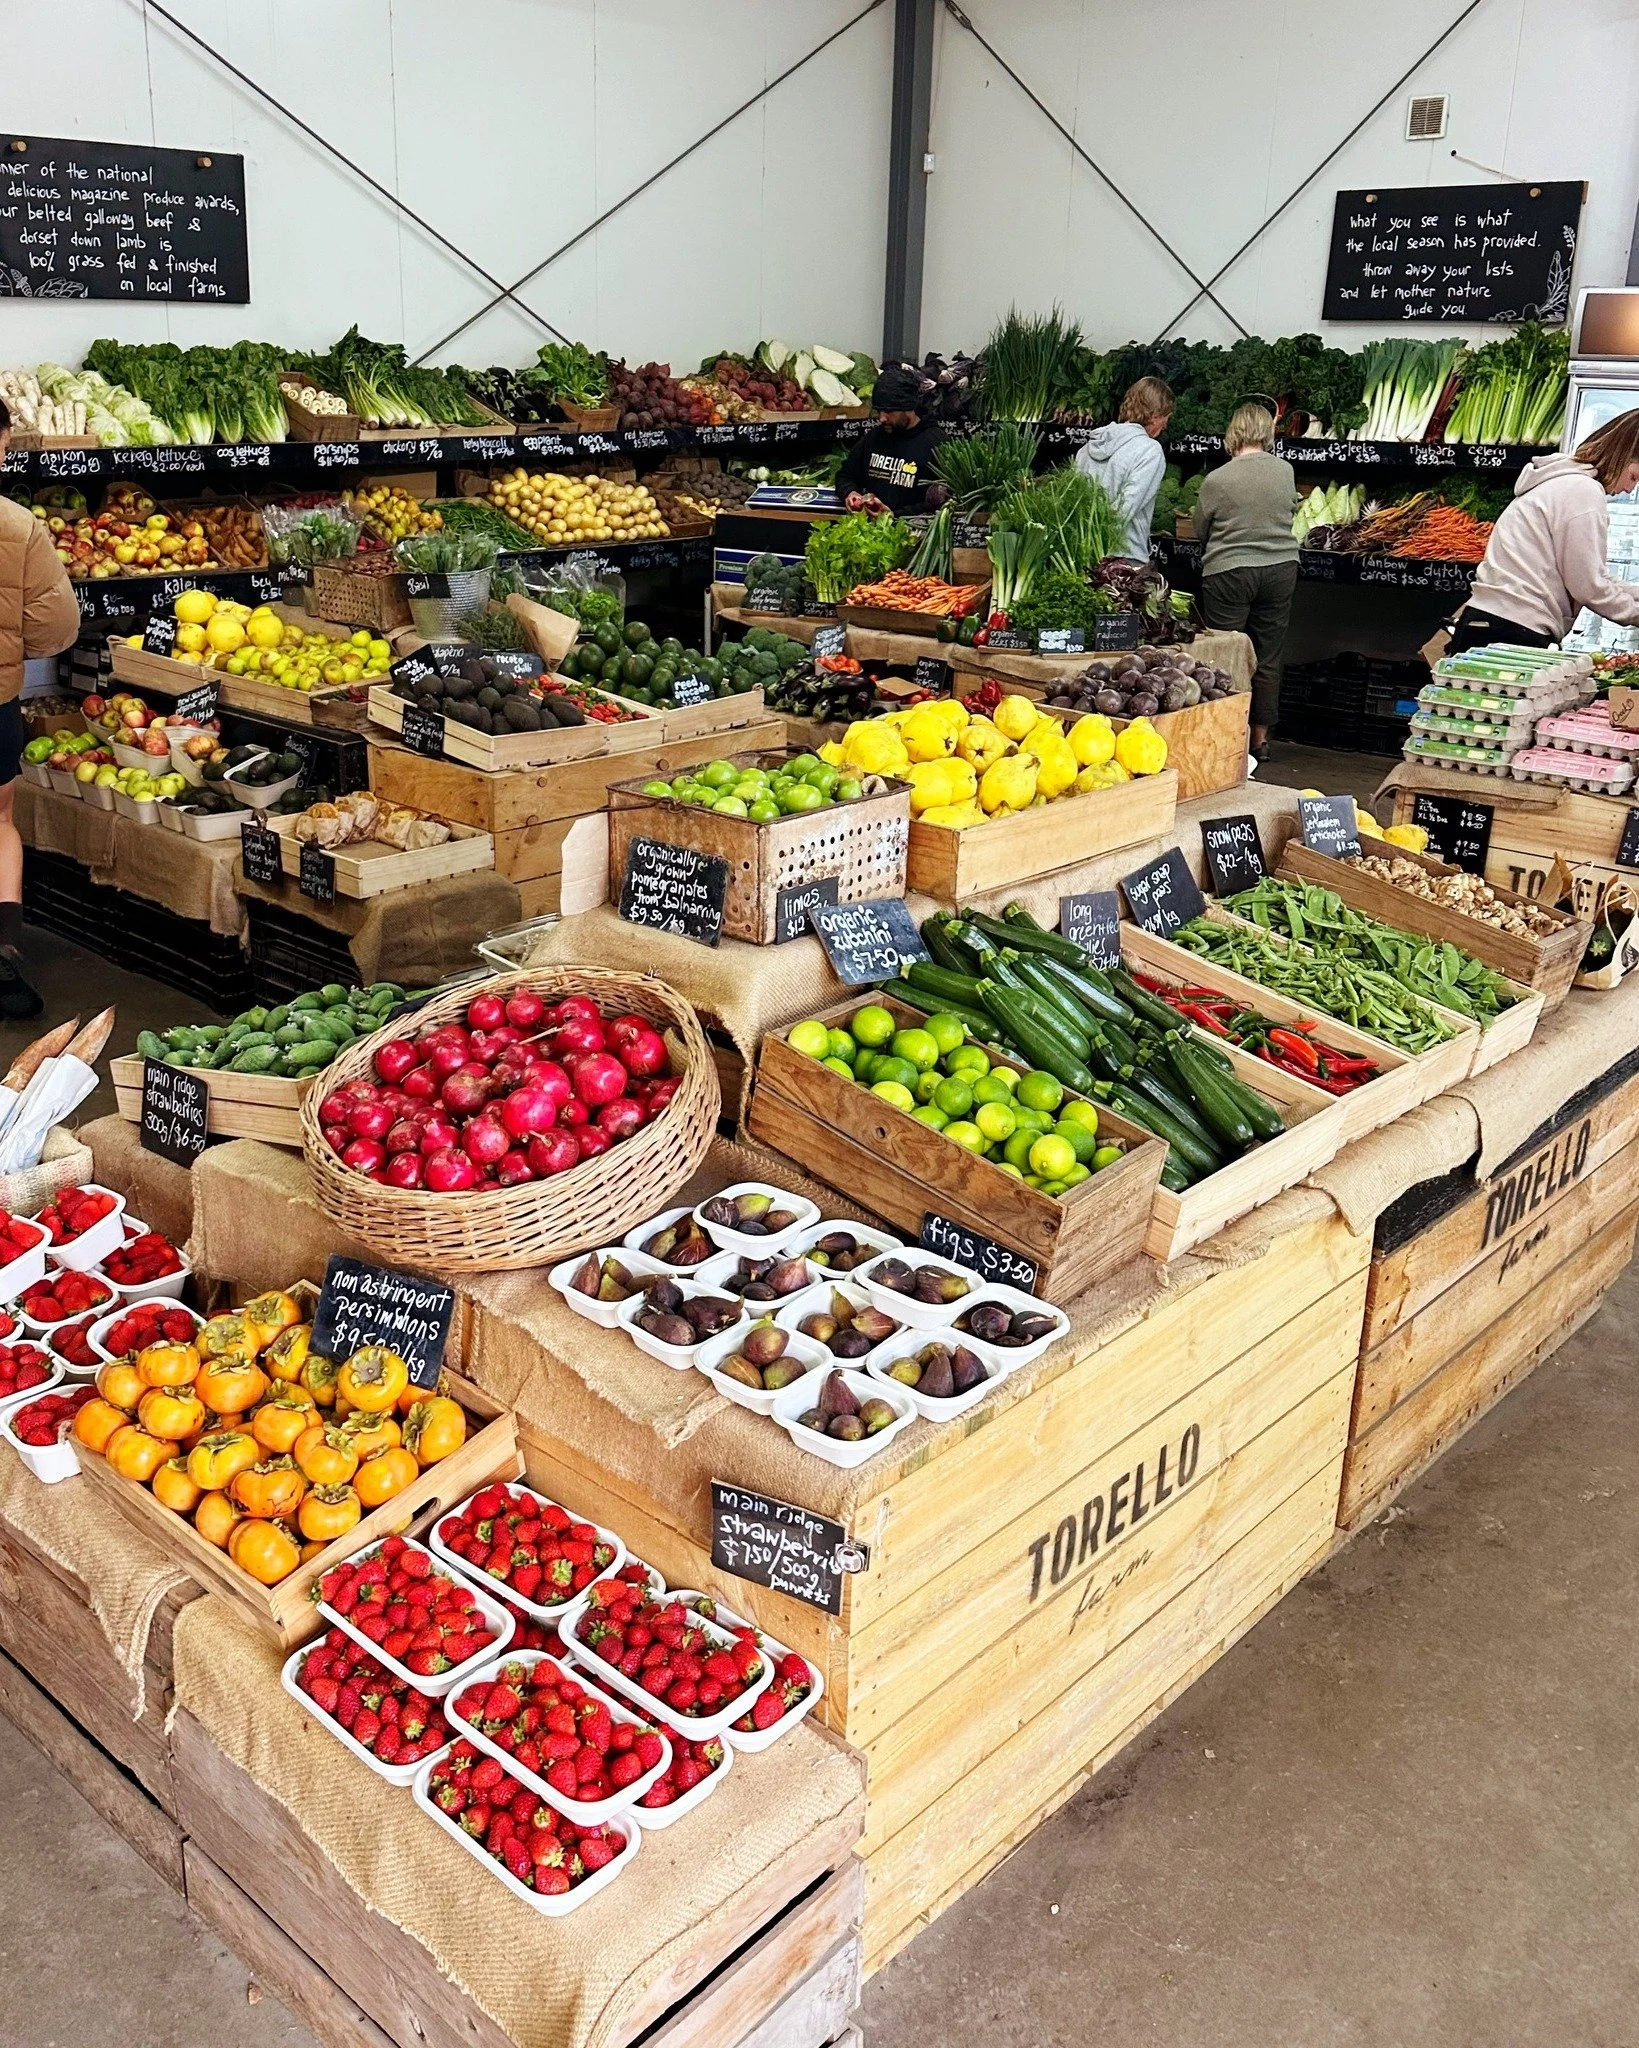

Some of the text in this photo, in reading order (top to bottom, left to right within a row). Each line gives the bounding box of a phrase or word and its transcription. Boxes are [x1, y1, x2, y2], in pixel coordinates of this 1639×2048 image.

[0, 161, 153, 185] nner of the national
[8, 181, 240, 216] delicious magazine produce awards,
[28, 202, 202, 232] belted galloway beef &
[1350, 208, 1513, 233] what you see is what
[19, 227, 173, 252] dorset down lamb is
[1346, 231, 1542, 257] the local season has provided.
[29, 250, 217, 275] 100% grass fed & finished
[1362, 260, 1514, 282] throw away your lists
[120, 275, 226, 297] on local farms
[1340, 281, 1492, 299] and let mother nature
[1403, 303, 1468, 319] guide you.
[1065, 426, 1091, 436] spinac
[40, 449, 86, 465] daikon
[113, 449, 201, 466] iceberg lettuce
[314, 442, 359, 459] parsnips
[1348, 441, 1376, 457] leeks
[1410, 445, 1455, 457] rhubarb
[1468, 446, 1506, 460] celery
[1474, 455, 1502, 467] $2.50
[0, 461, 27, 473] arlic
[869, 452, 905, 471] TORELLO
[889, 471, 916, 488] FARM
[1360, 570, 1398, 584] carrots
[1424, 563, 1462, 579] dutch
[674, 674, 698, 690] reed
[674, 682, 710, 700] avocado
[1303, 801, 1332, 821] organic
[637, 843, 697, 876] organically
[654, 863, 686, 881] grown
[631, 870, 707, 899] pomegranates
[1130, 876, 1151, 904] sugar
[1152, 881, 1171, 909] peas
[635, 886, 721, 929] from balnarring
[785, 888, 820, 918] limes
[1069, 900, 1092, 926] long
[820, 904, 877, 932] organic
[147, 1067, 198, 1101] main ridge
[147, 1088, 203, 1127] strawberries
[1481, 1118, 1591, 1250] TORELLO
[929, 1216, 1034, 1283] figs $3.50
[719, 1489, 824, 1549] main ridge
[1027, 1422, 1201, 1603] TORELLO
[769, 1574, 831, 1606] punnets
[1069, 1549, 1154, 1636] farm
